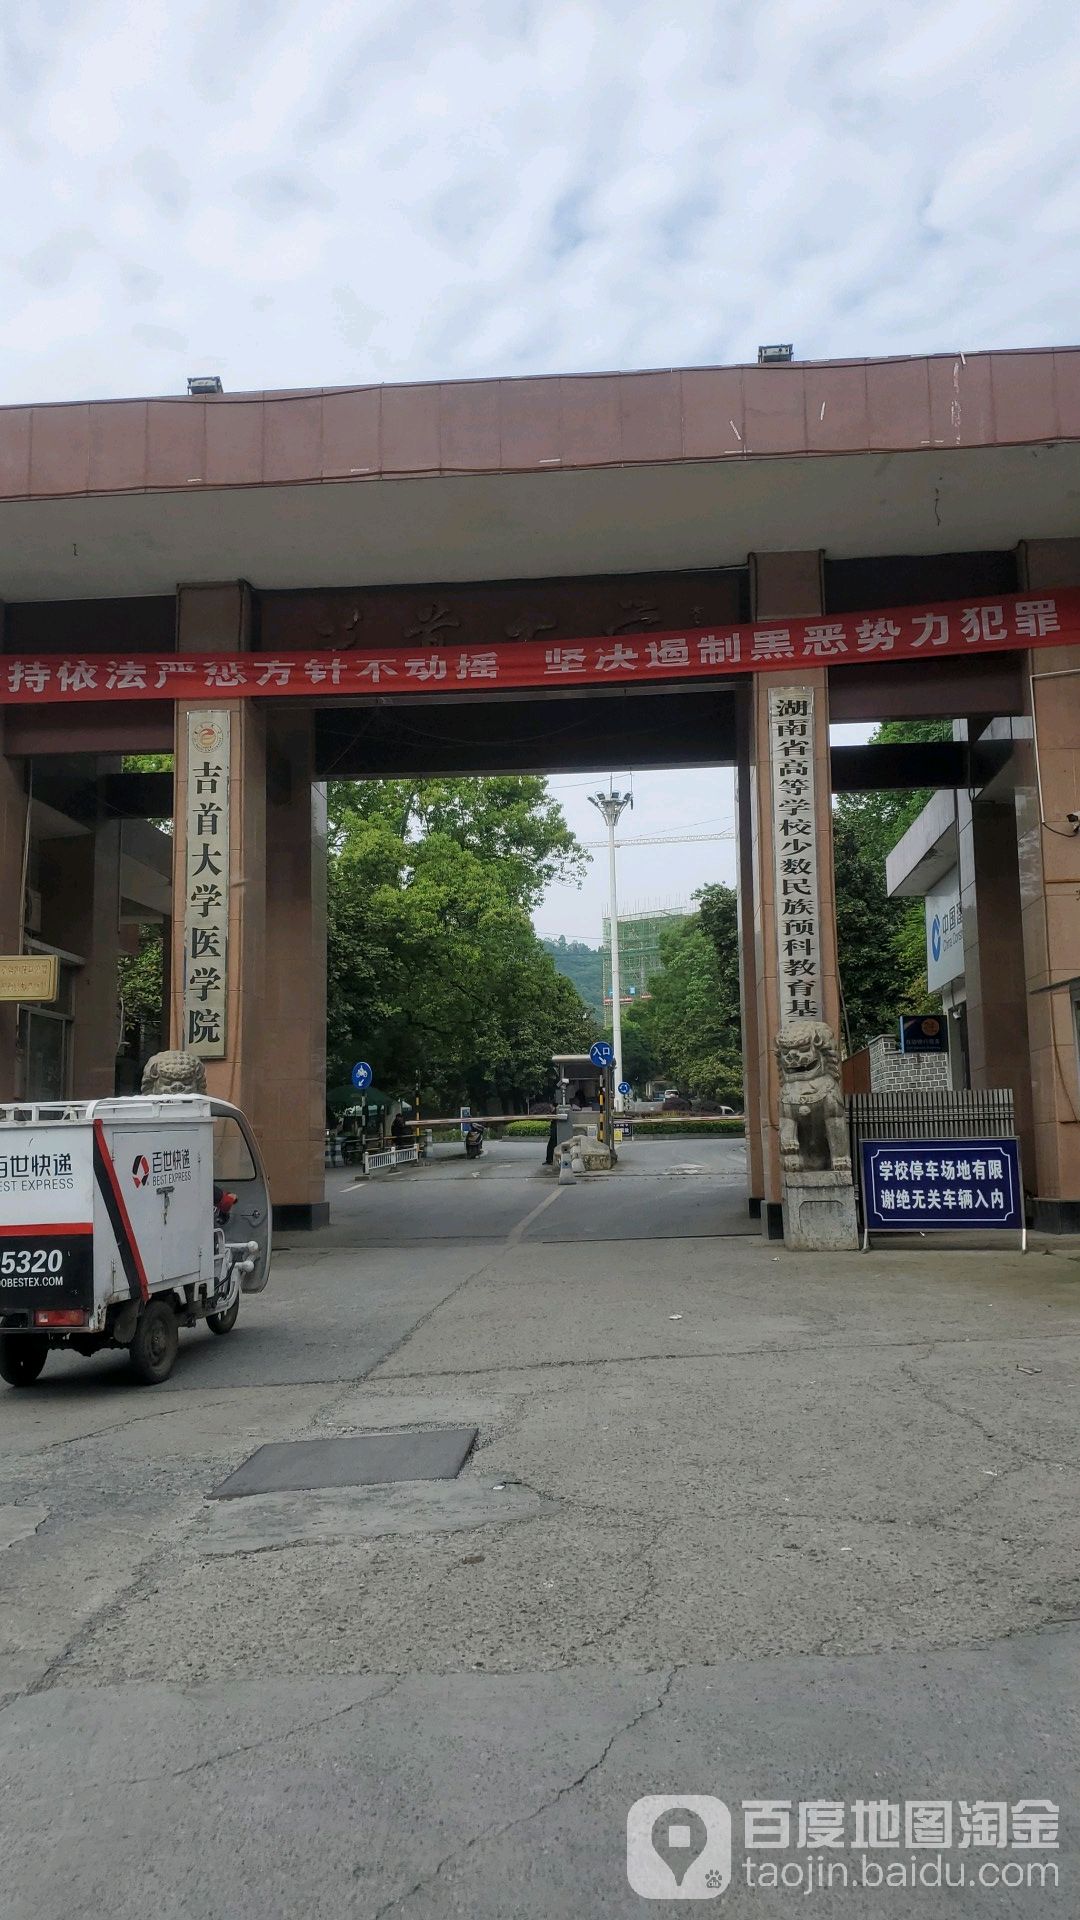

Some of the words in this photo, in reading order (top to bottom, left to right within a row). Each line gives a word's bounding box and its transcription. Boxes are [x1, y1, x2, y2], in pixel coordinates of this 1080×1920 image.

[544, 599, 1061, 674] 坚决遏制黑恶势力犯罪
[776, 699, 818, 1022] 湖南省高等学校少数民族预科教育基
[189, 761, 222, 1044] 吉首大学医学院
[593, 1047, 610, 1056] 入口
[152, 1149, 190, 1173] 百世快递
[879, 1159, 1004, 1181] 学校停车场地有限
[21, 1178, 74, 1192] EXPRESS
[152, 1174, 167, 1187] BEST
[168, 1170, 191, 1184] EXPRESS
[881, 1188, 1004, 1210] 谢绝无关车辆入内
[1, 1249, 63, 1274] 5320
[0, 1276, 63, 1288] 0BESTEX.COM
